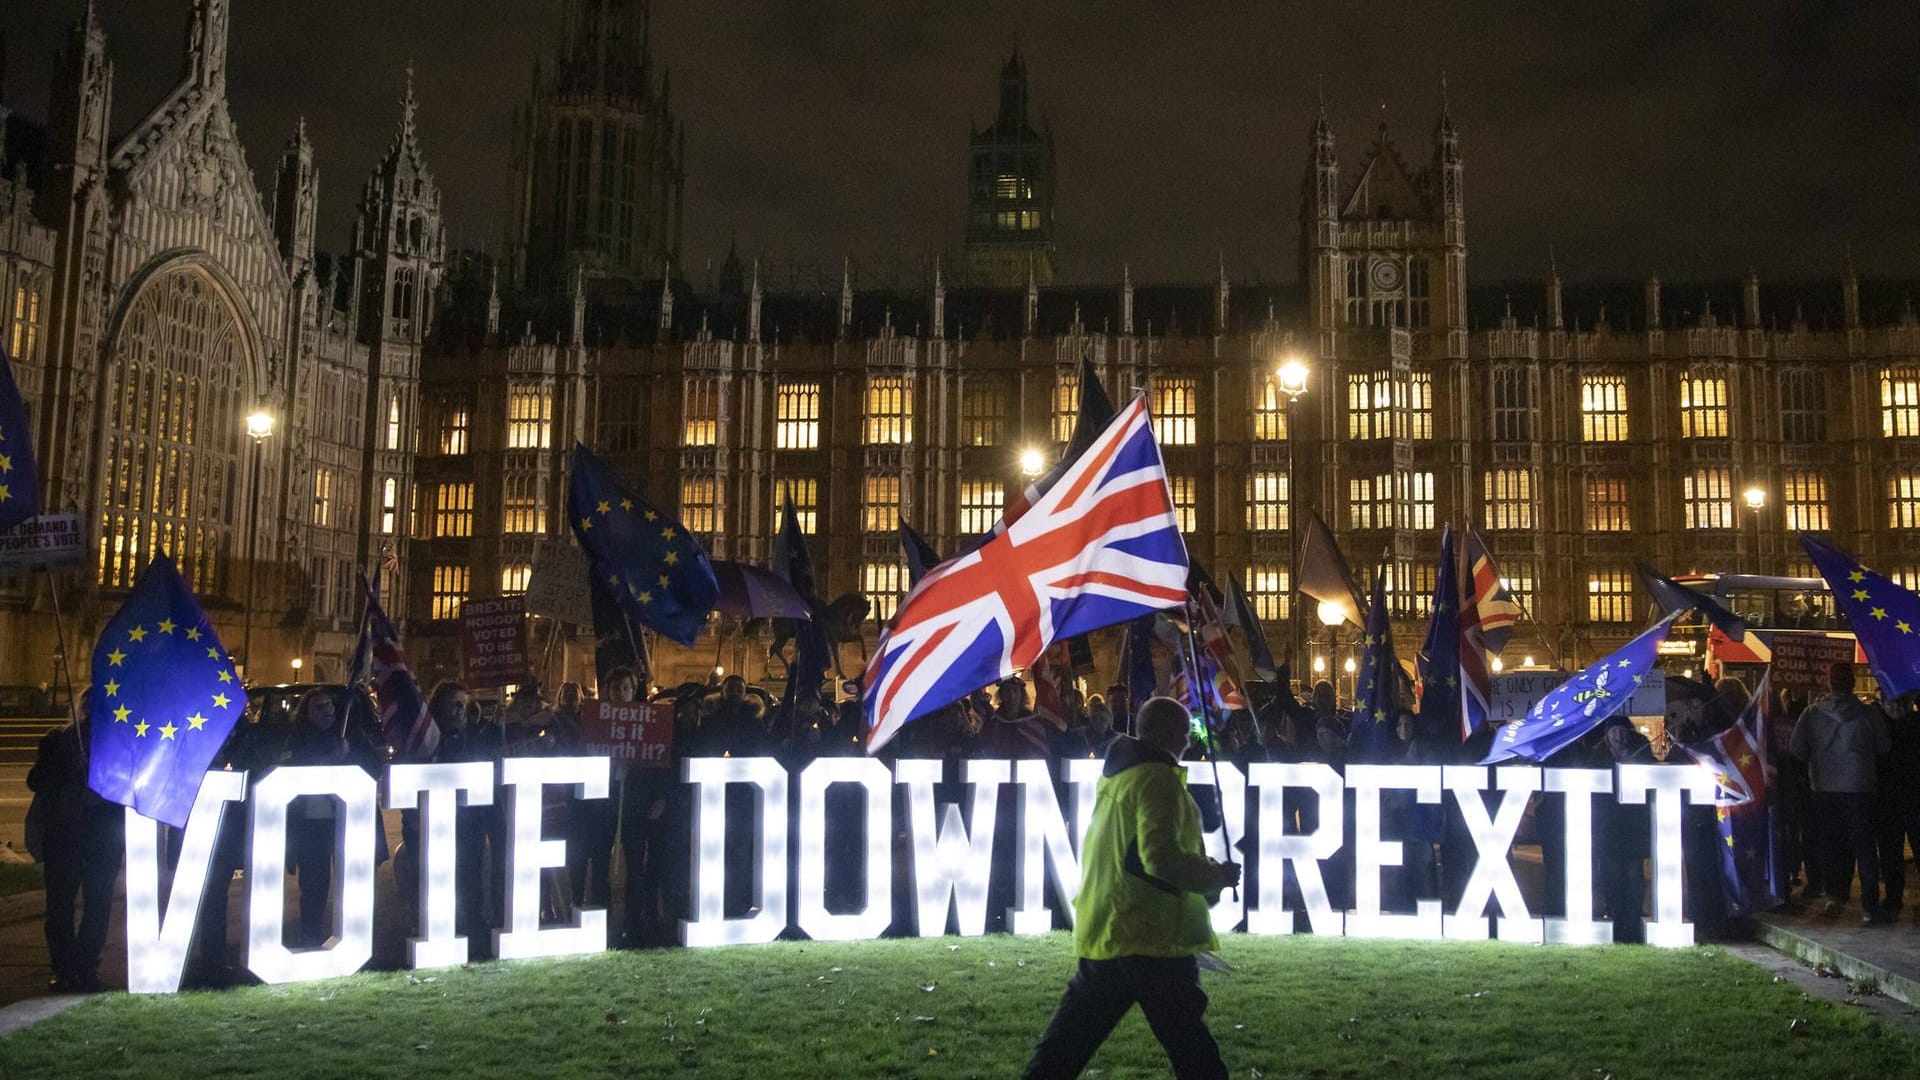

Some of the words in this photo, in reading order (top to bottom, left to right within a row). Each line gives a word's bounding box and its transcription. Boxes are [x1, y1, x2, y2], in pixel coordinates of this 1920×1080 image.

[20, 520, 67, 535] DEMAND
[71, 520, 79, 532] A
[0, 535, 50, 549] PEOPLE'S
[54, 533, 81, 546] VOTE
[465, 600, 521, 615] BREXIT:
[466, 613, 521, 628] NOBODY
[472, 627, 517, 641] VOTED
[477, 642, 495, 653] TO
[497, 640, 513, 652] BE
[1776, 645, 1806, 657] OUR
[1808, 648, 1851, 661] VOICE
[469, 653, 522, 667] POORER
[1777, 659, 1807, 671] OUR
[1506, 676, 1535, 694] ONLY
[1784, 672, 1811, 684] OUR
[600, 702, 656, 723] Brexit:
[1501, 700, 1514, 718] IS
[610, 722, 625, 740] is
[631, 723, 645, 741] it
[587, 742, 636, 759] worth
[641, 743, 665, 760] it?
[124, 756, 610, 994] VOTE
[682, 757, 1104, 948] DOWN
